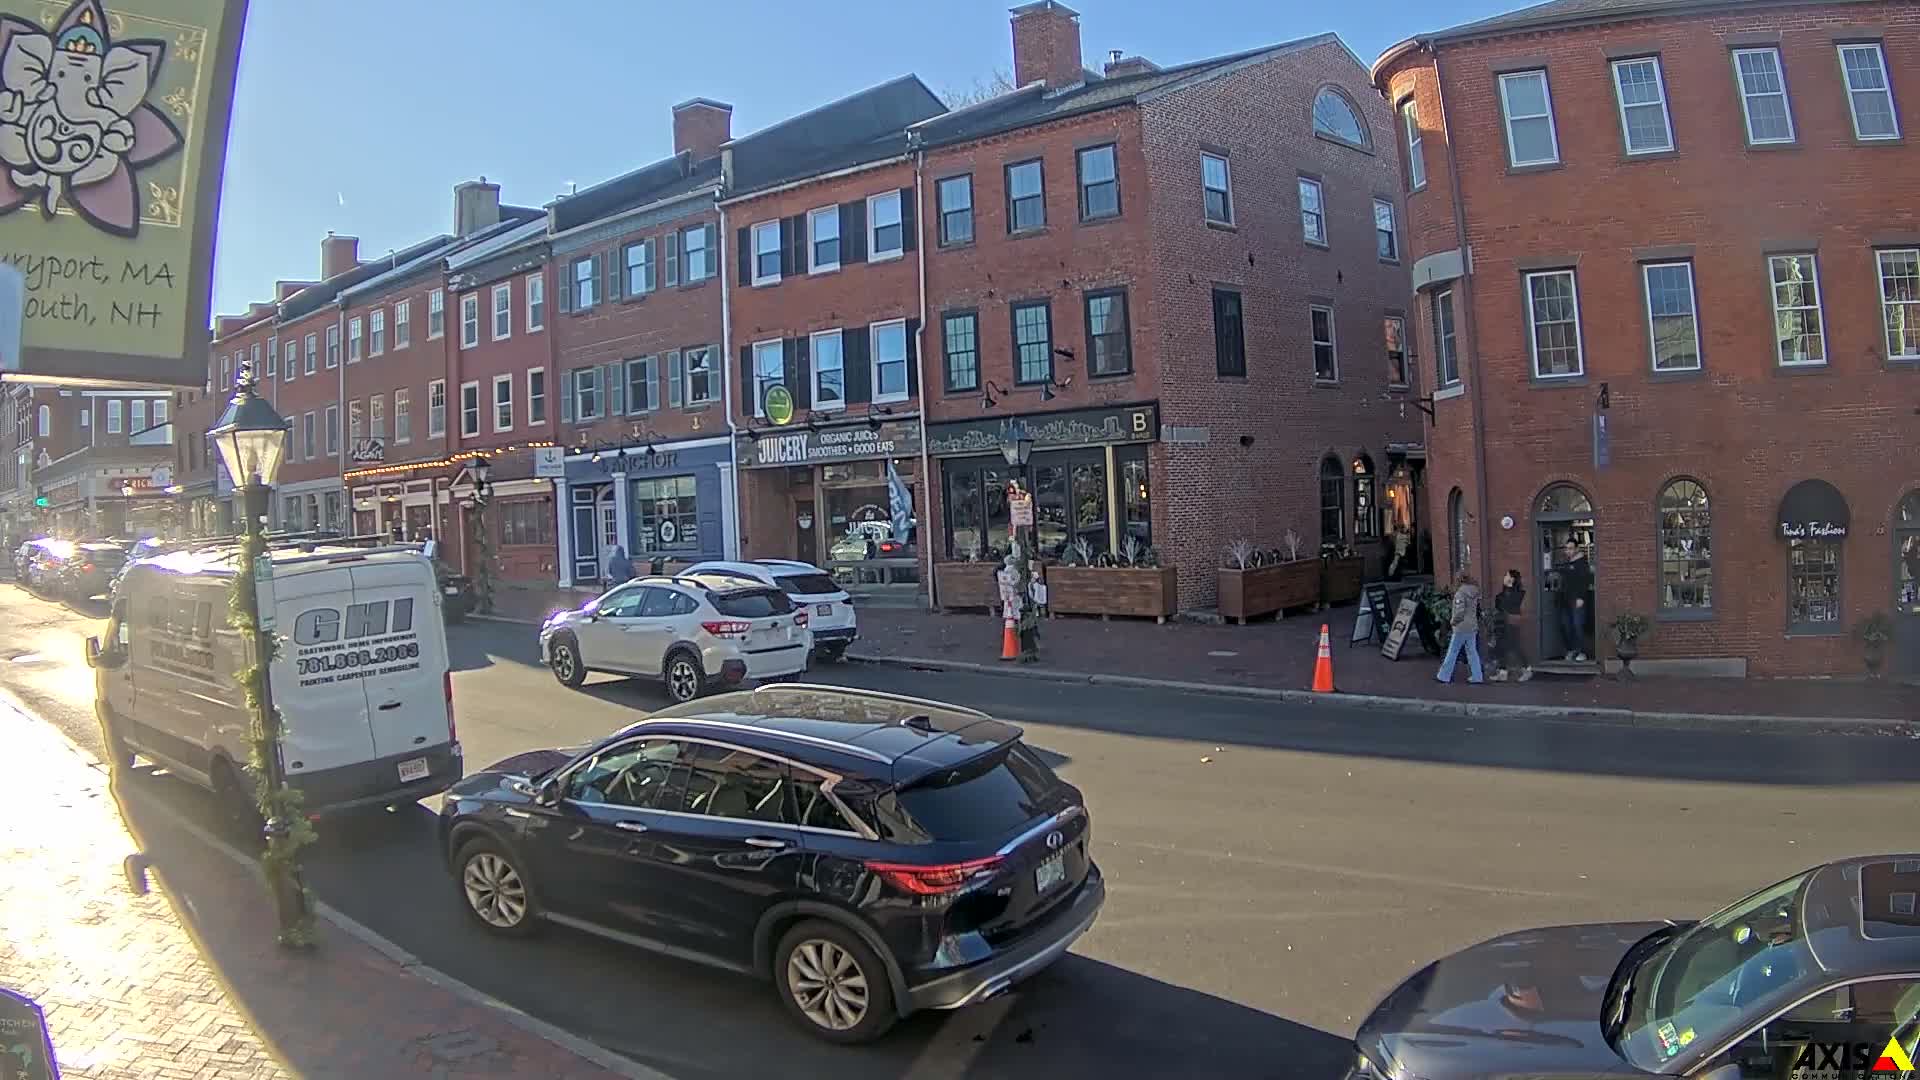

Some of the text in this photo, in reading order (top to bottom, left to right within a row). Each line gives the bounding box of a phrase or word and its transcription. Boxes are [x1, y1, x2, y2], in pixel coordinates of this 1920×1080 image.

[120, 259, 176, 288] MA
[110, 300, 162, 328] NH
[1133, 412, 1147, 432] B
[757, 434, 808, 464] JUICERY
[807, 441, 895, 458] SMOOTHIES GOOD EATS
[820, 430, 879, 445] ORGANIC JUICES
[1782, 522, 1805, 537] Tina's
[294, 597, 414, 646] GHI
